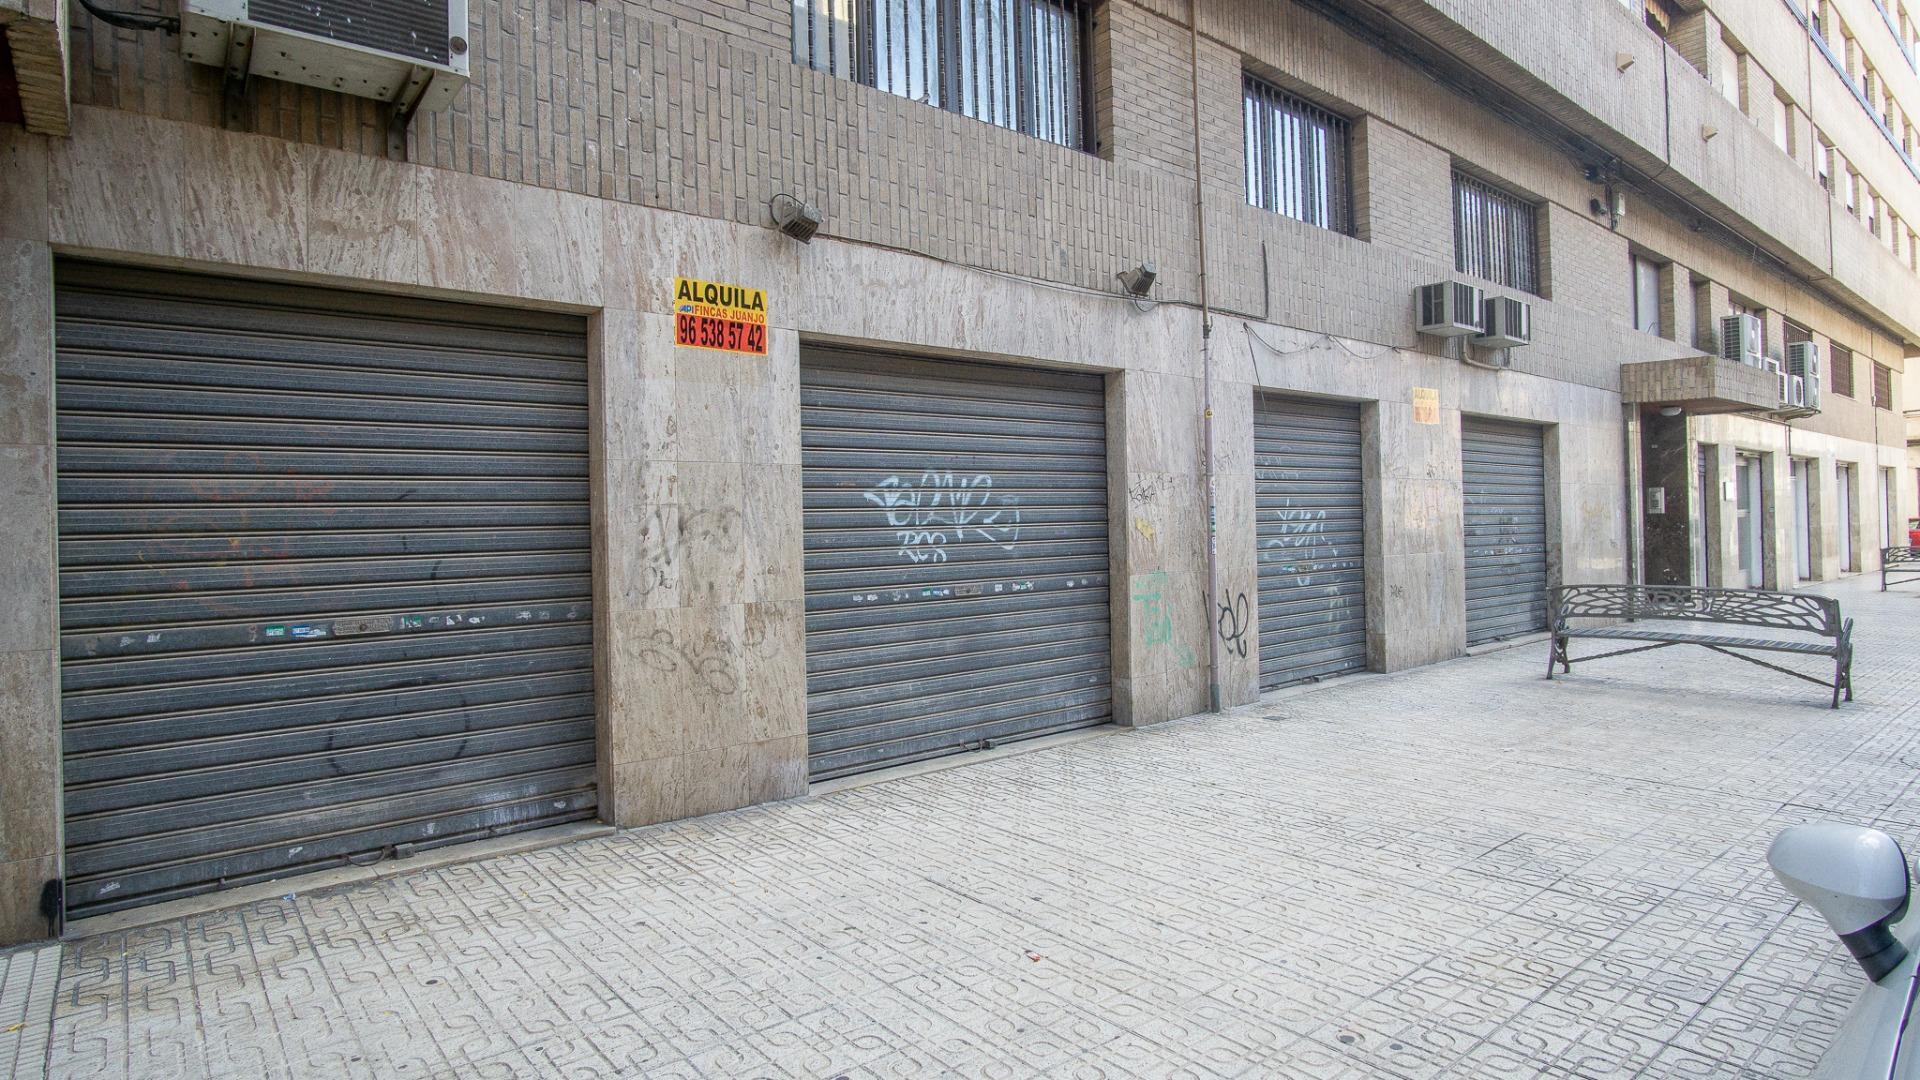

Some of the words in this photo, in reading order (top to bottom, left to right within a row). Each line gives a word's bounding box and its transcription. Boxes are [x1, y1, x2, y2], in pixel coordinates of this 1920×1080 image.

[678, 280, 764, 311] ALQUILA
[695, 305, 728, 319] FINCAS
[730, 310, 765, 324] JUANJO
[680, 314, 696, 344] 96
[701, 317, 724, 348] 538
[728, 321, 744, 350] 57
[747, 324, 762, 352] 42
